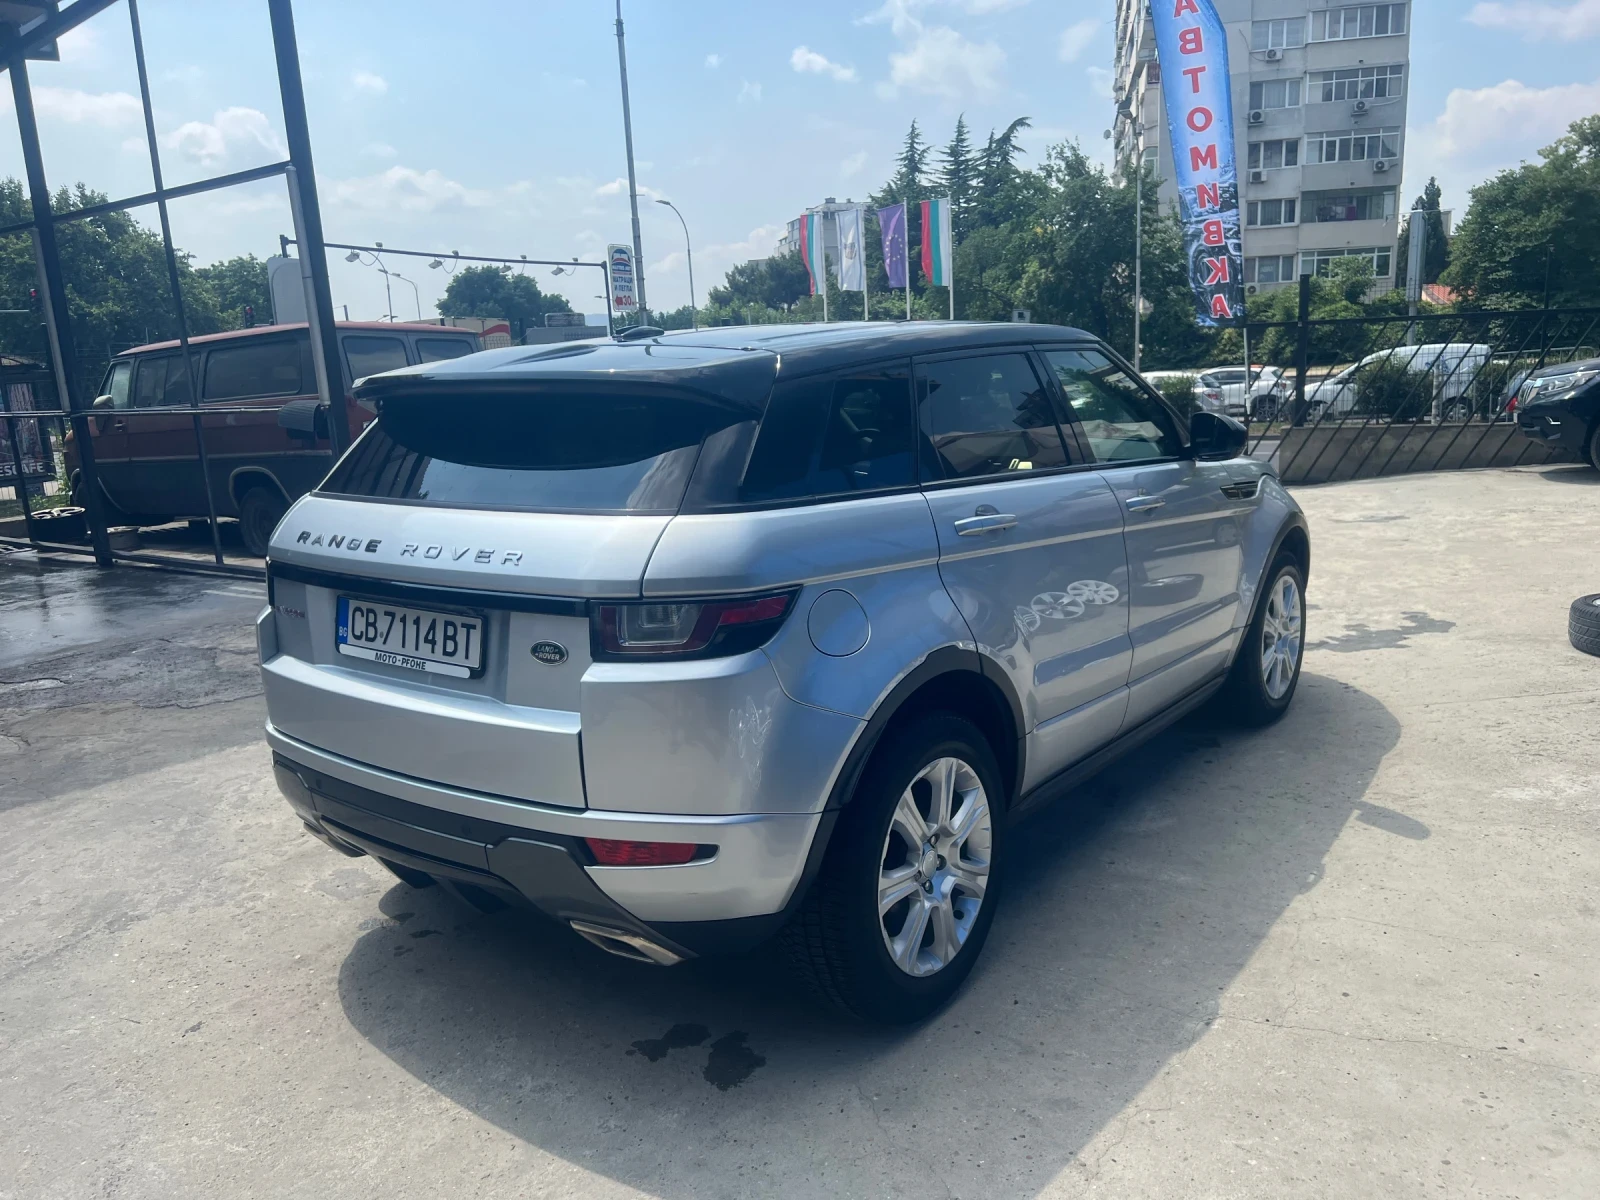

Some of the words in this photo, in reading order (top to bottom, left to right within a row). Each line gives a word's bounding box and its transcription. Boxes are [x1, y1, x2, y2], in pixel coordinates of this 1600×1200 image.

[296, 530, 382, 553] RANGE
[400, 542, 524, 566] ROVER
[338, 626, 348, 637] BG
